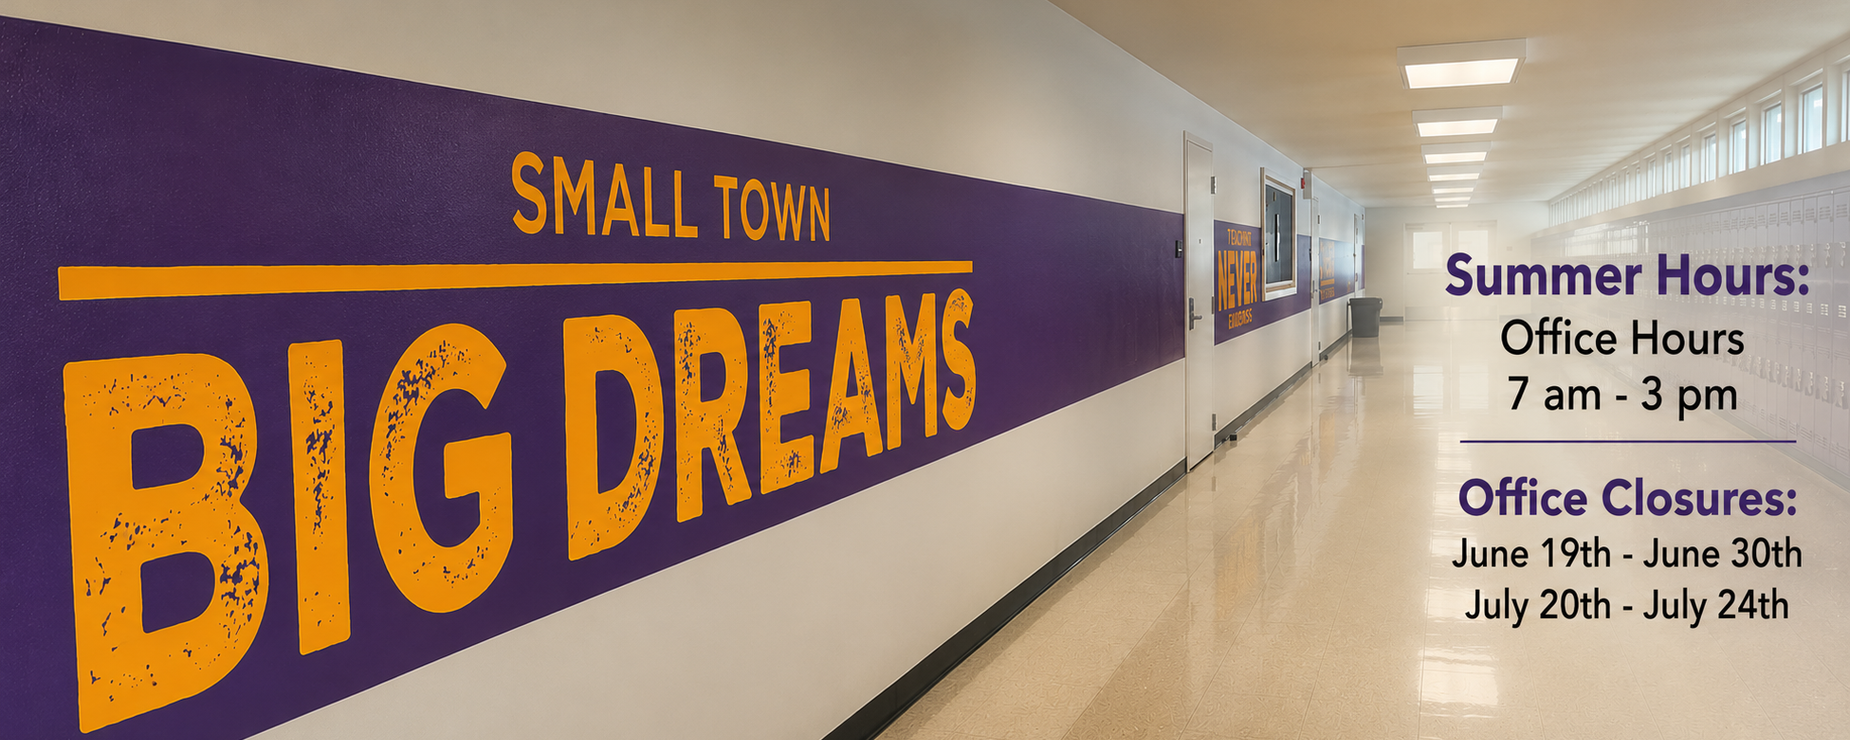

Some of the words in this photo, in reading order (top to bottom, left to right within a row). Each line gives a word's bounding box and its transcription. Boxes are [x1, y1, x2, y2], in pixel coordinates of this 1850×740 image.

[512, 151, 698, 239] SMALL
[714, 175, 830, 242] TOWN
[1217, 250, 1258, 312] NEVER
[63, 323, 514, 734] BIG
[563, 288, 977, 562] DREAMS
